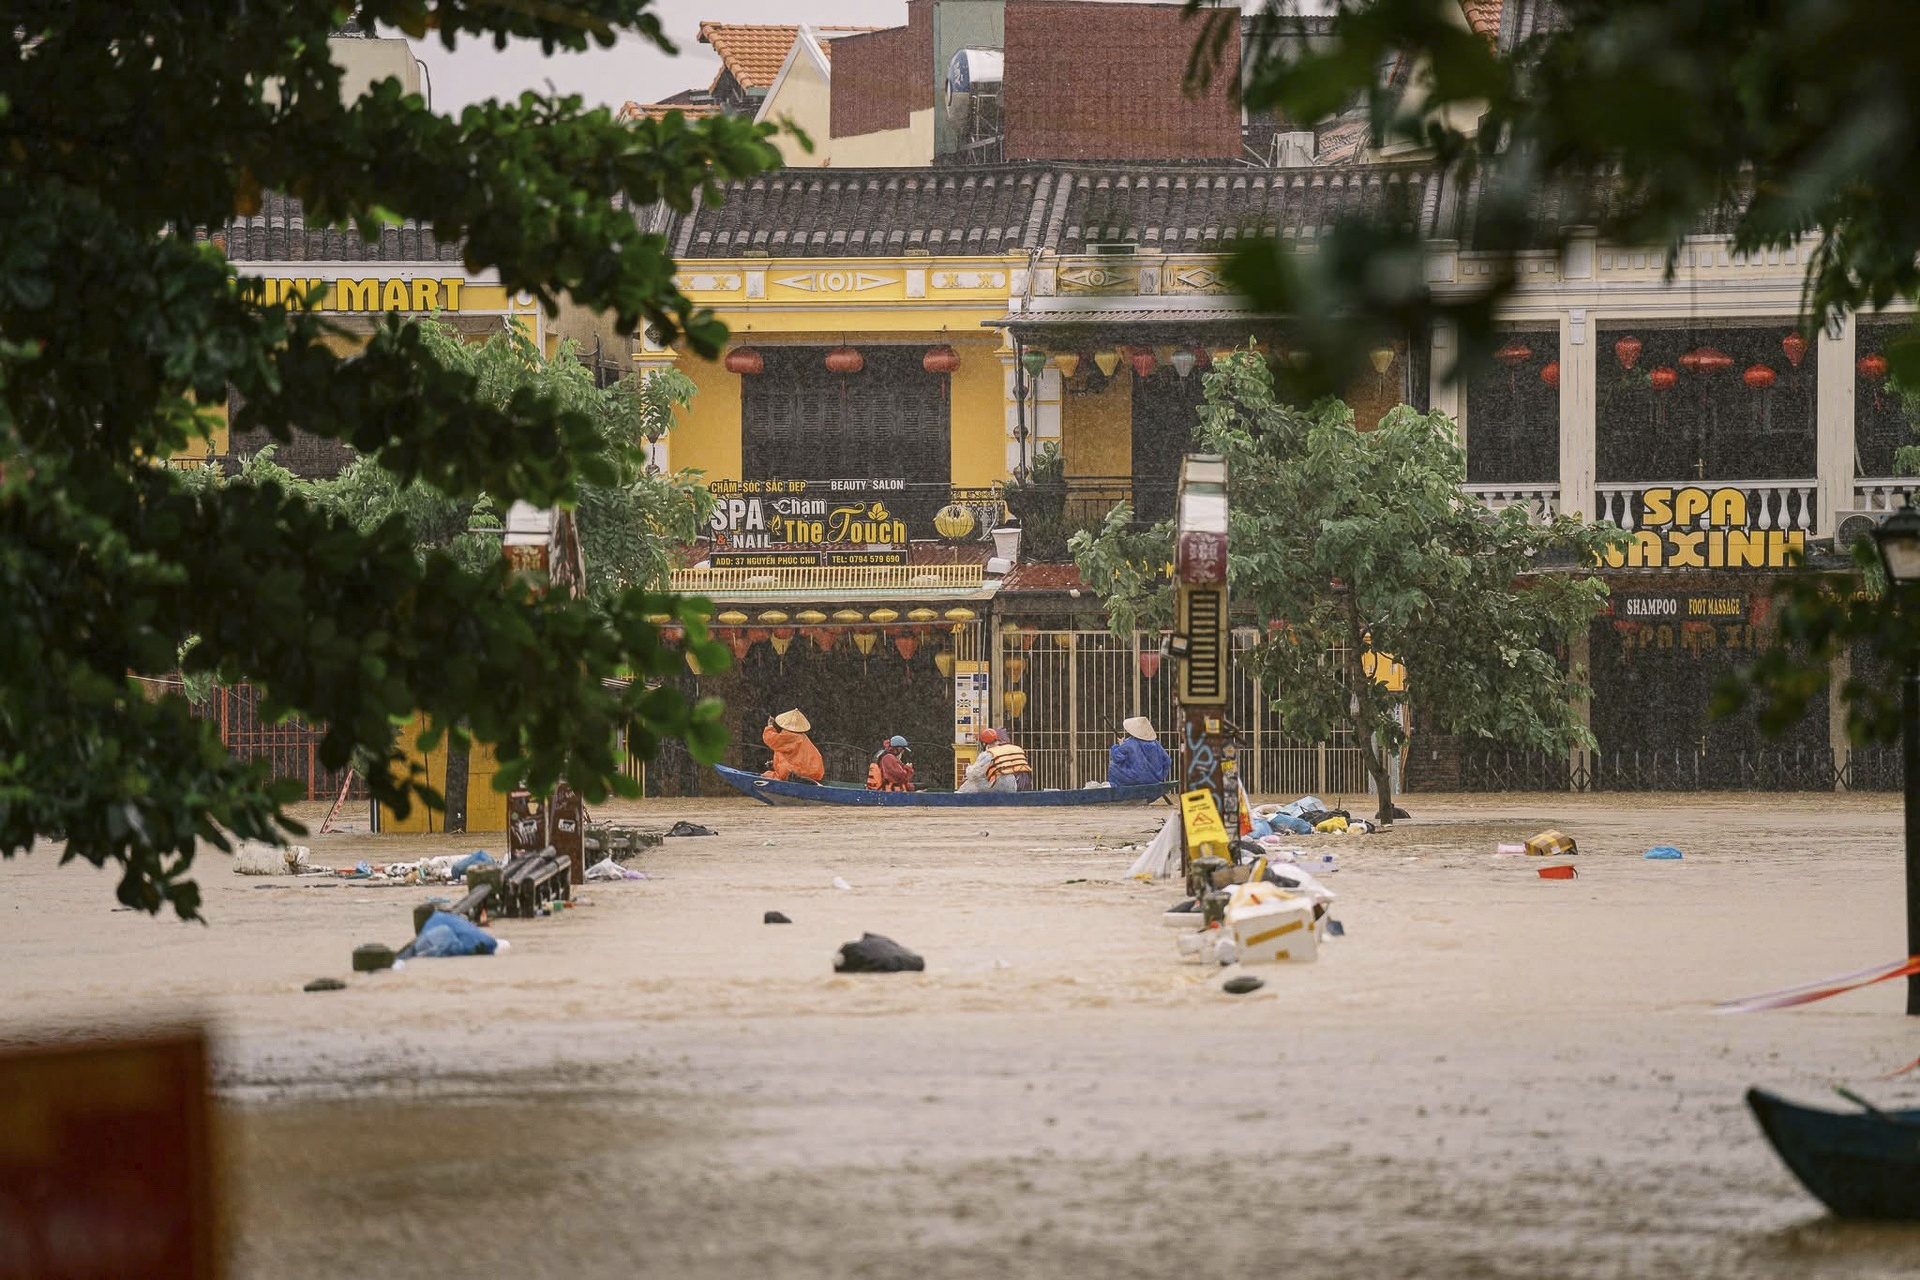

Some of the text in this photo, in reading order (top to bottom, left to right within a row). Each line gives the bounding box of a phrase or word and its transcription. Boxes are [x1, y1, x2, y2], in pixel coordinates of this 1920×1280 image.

[227, 278, 465, 311] INI MART
[743, 479, 760, 493] SÓC
[831, 479, 904, 491] BEAUTY SALON
[710, 498, 764, 531] SPA
[1642, 487, 1746, 526] SPA
[784, 502, 905, 544] The Touch
[716, 533, 772, 549] & NAIL
[715, 557, 734, 565] ADD:
[735, 557, 745, 565] 37
[799, 556, 816, 565] CHU
[832, 554, 900, 563] TEL: 0794 579 690
[1626, 598, 1677, 615] SHAMPOO
[1688, 598, 1740, 615] FOOT MASSAGE
